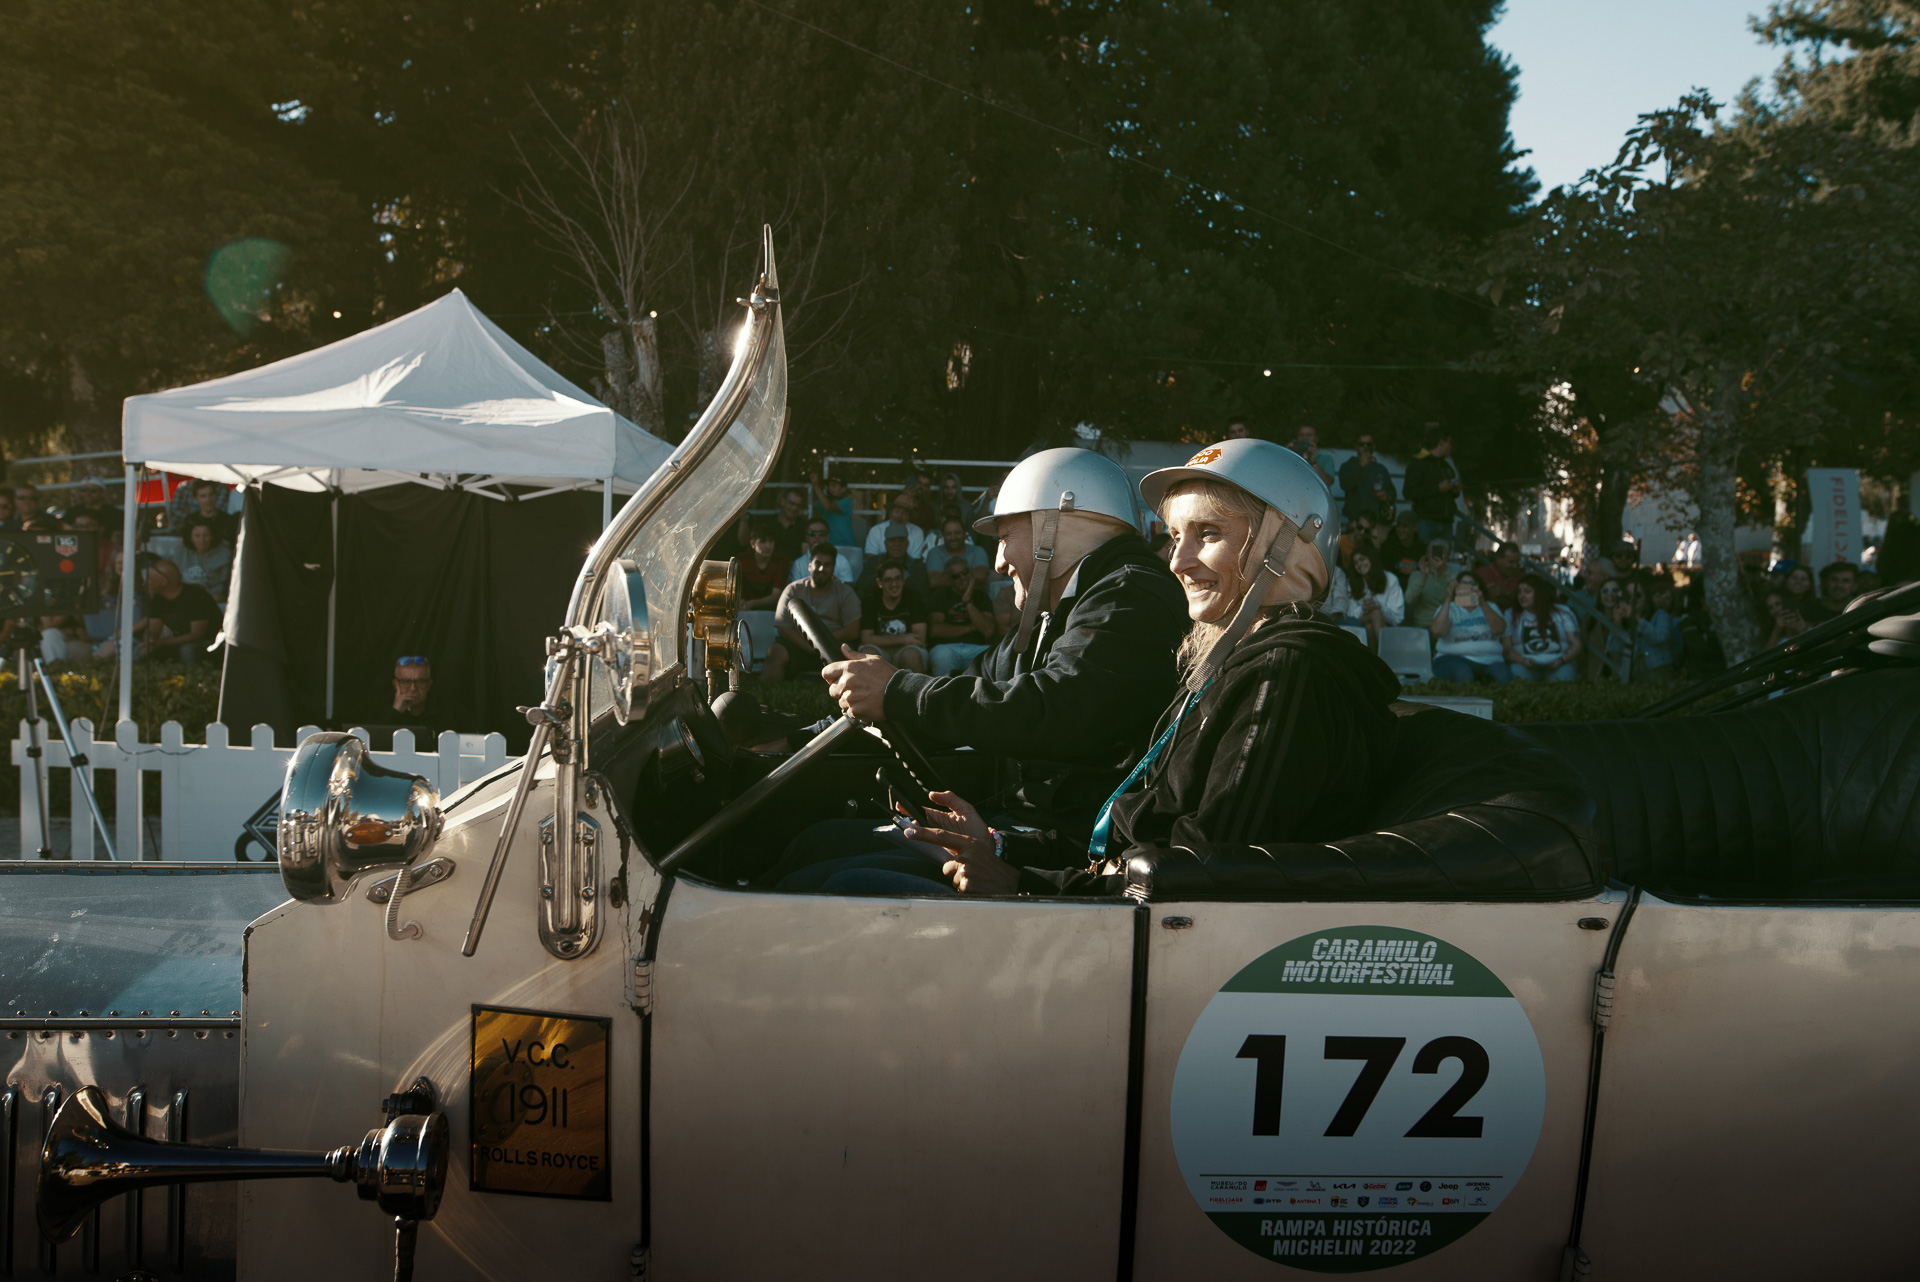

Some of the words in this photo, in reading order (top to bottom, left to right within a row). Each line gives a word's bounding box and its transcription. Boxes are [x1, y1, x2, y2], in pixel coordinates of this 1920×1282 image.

[1311, 938, 1438, 963] CARAMULO
[1281, 960, 1455, 985] MOTORFESTIVAL
[502, 1037, 575, 1070] V.C.C.
[1235, 1034, 1490, 1138] 172
[510, 1083, 568, 1129] 1911
[480, 1146, 538, 1166] ROLLS
[541, 1152, 599, 1171] ROYCE
[1438, 1182, 1459, 1191] Jeep
[1260, 1219, 1327, 1237] RAMPA
[1332, 1216, 1432, 1237] HISTÓRICA
[1272, 1239, 1365, 1256] MICHELIN
[1369, 1239, 1417, 1256] 2022
